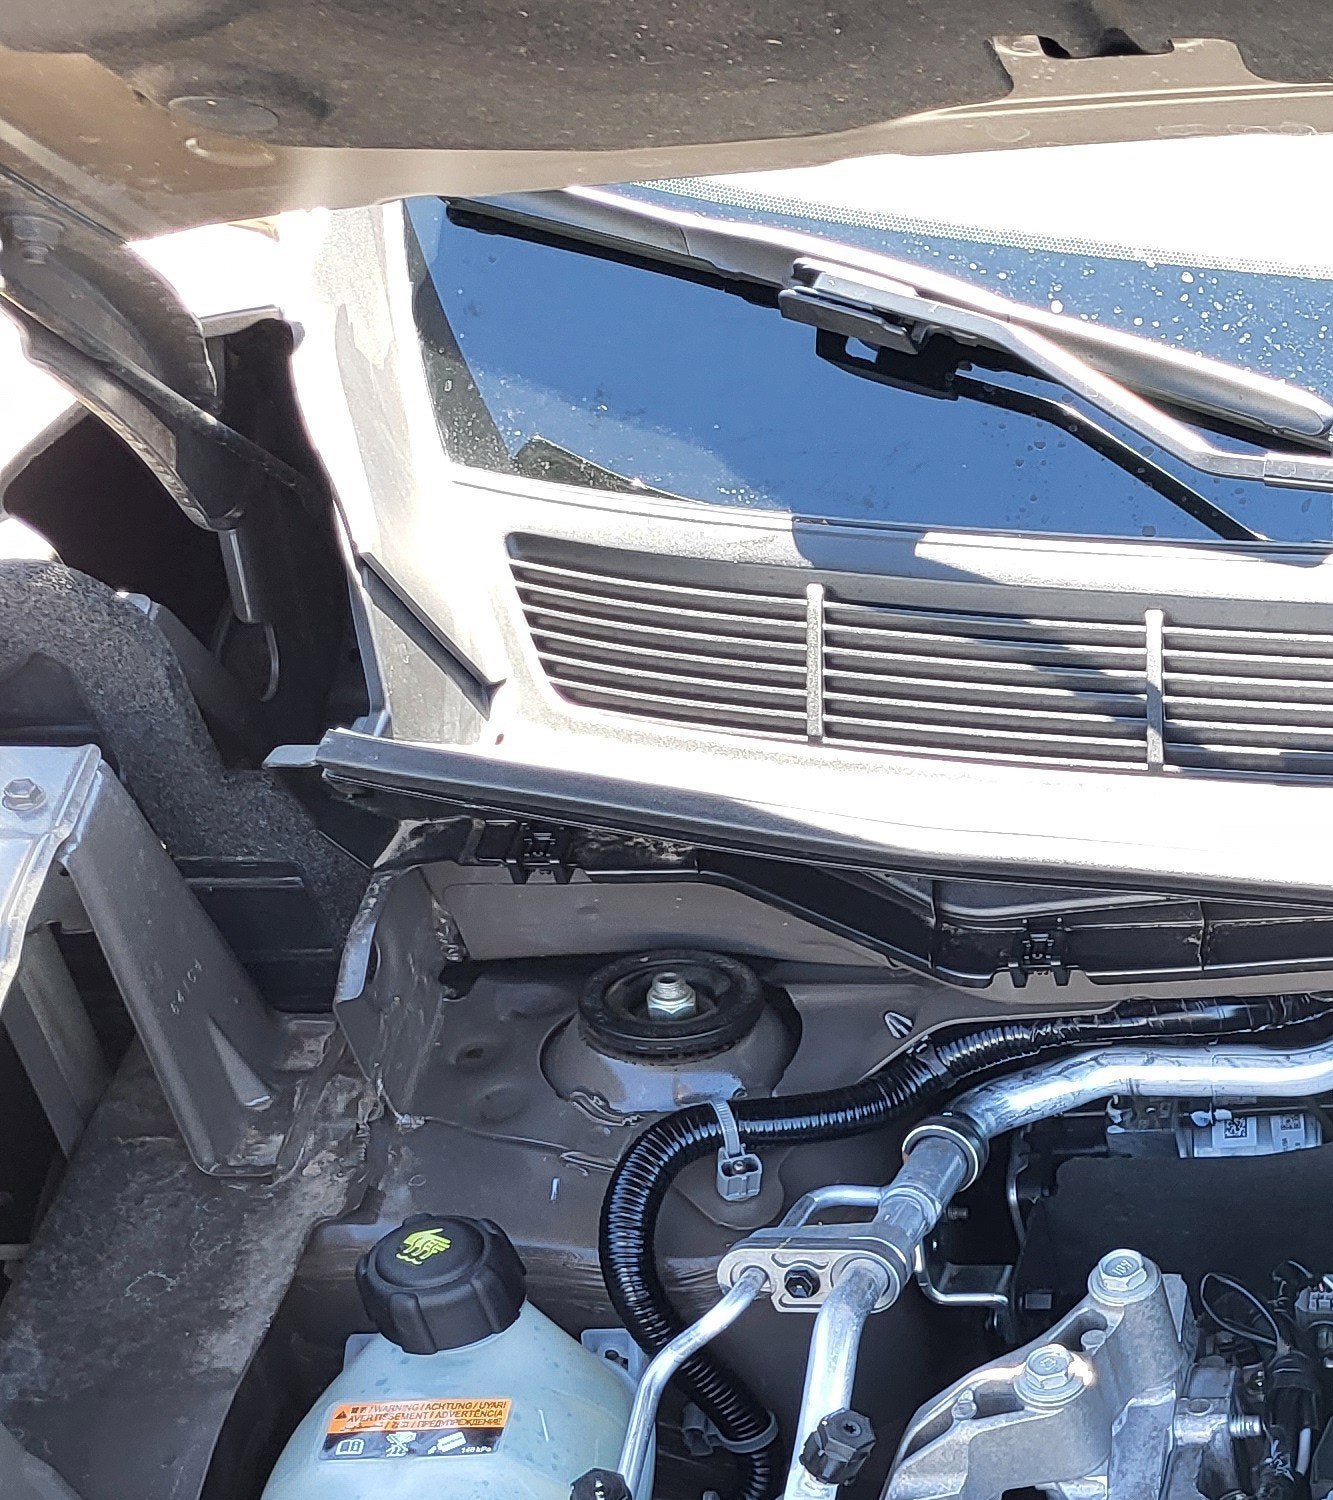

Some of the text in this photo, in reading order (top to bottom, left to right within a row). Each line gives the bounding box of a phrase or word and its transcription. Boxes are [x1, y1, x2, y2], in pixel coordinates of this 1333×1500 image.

[374, 1404, 421, 1414] WARNING
[426, 1402, 473, 1412] ACHTUNG
[478, 1401, 506, 1410] UYARI
